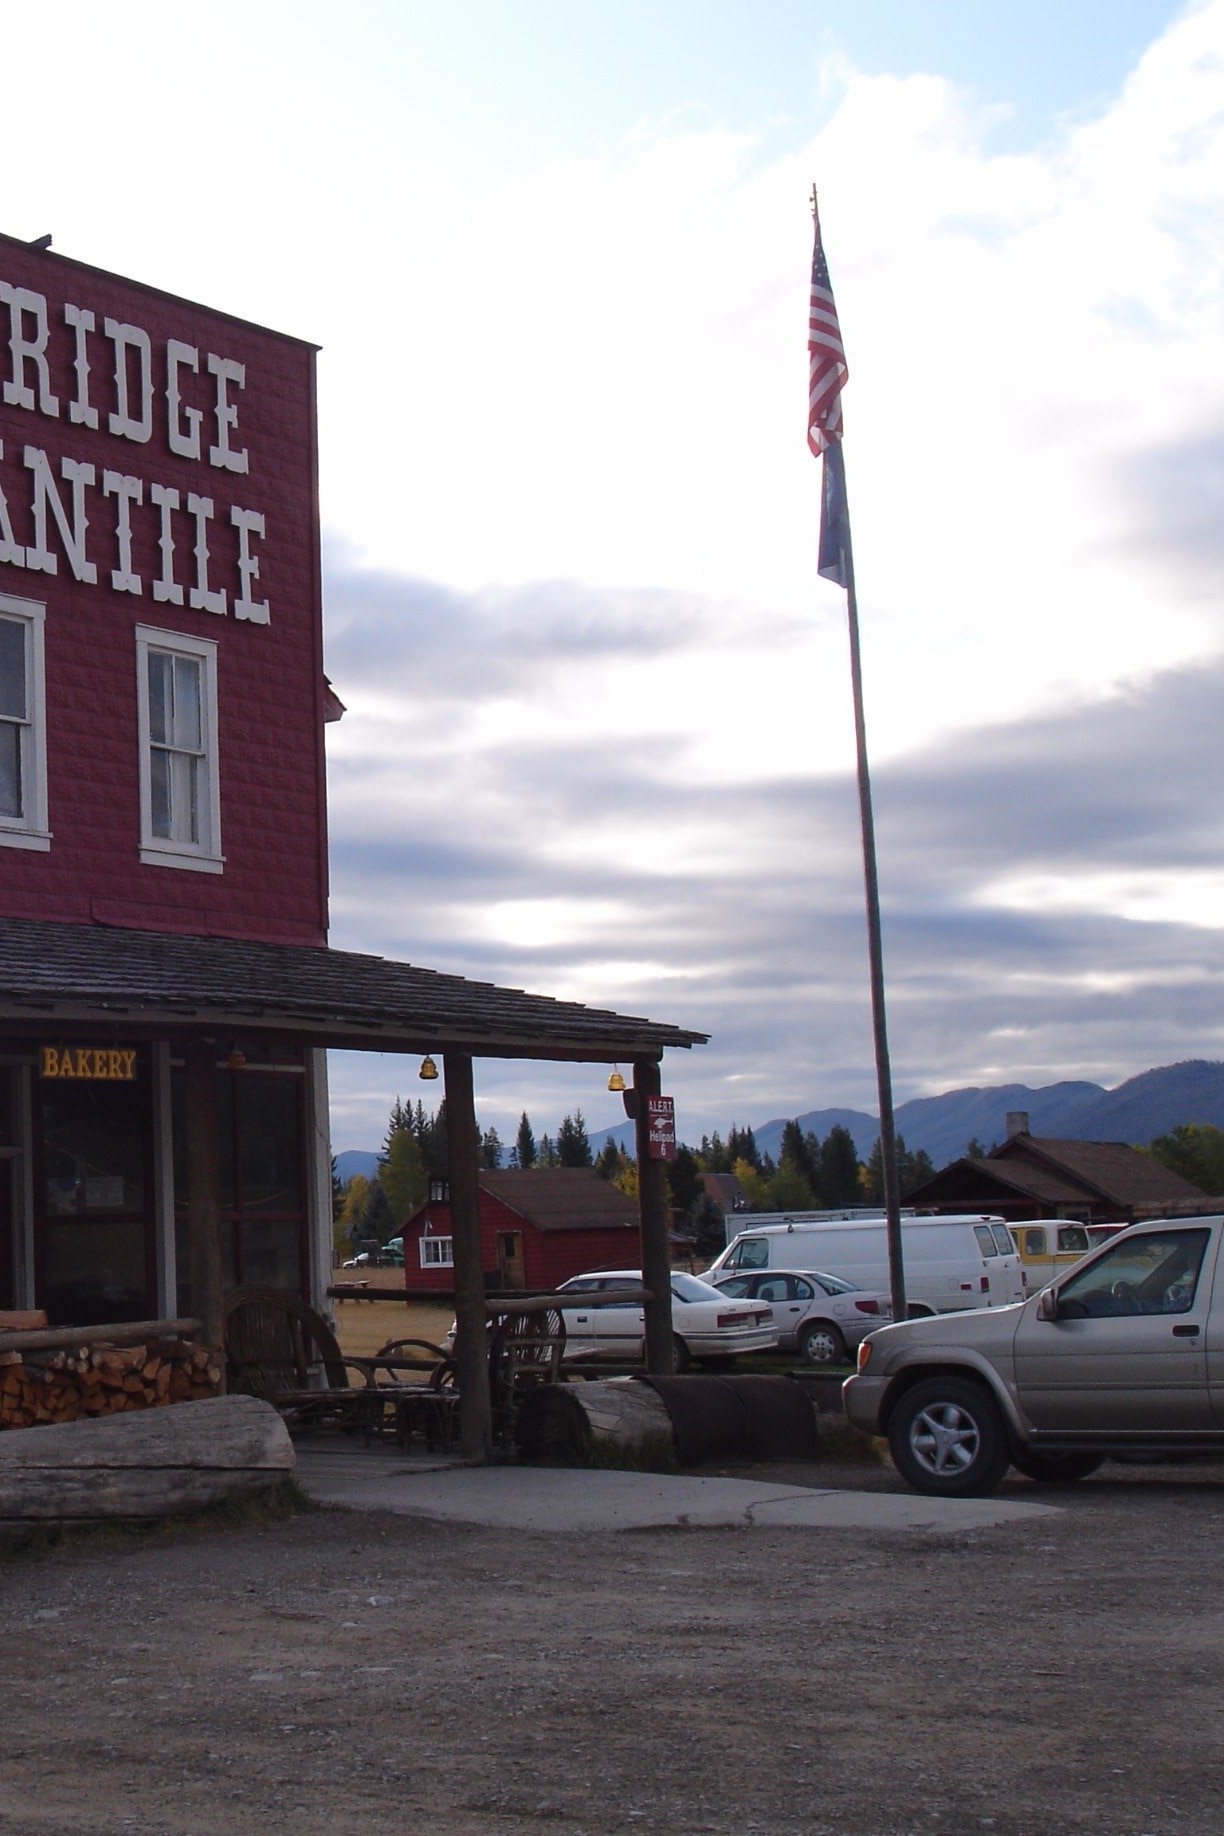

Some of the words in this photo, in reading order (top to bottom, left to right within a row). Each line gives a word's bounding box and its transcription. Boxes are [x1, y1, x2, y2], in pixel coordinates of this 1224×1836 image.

[42, 1047, 137, 1079] BAKERY
[649, 1100, 673, 1112] ALERT
[649, 1130, 675, 1143] Helipad
